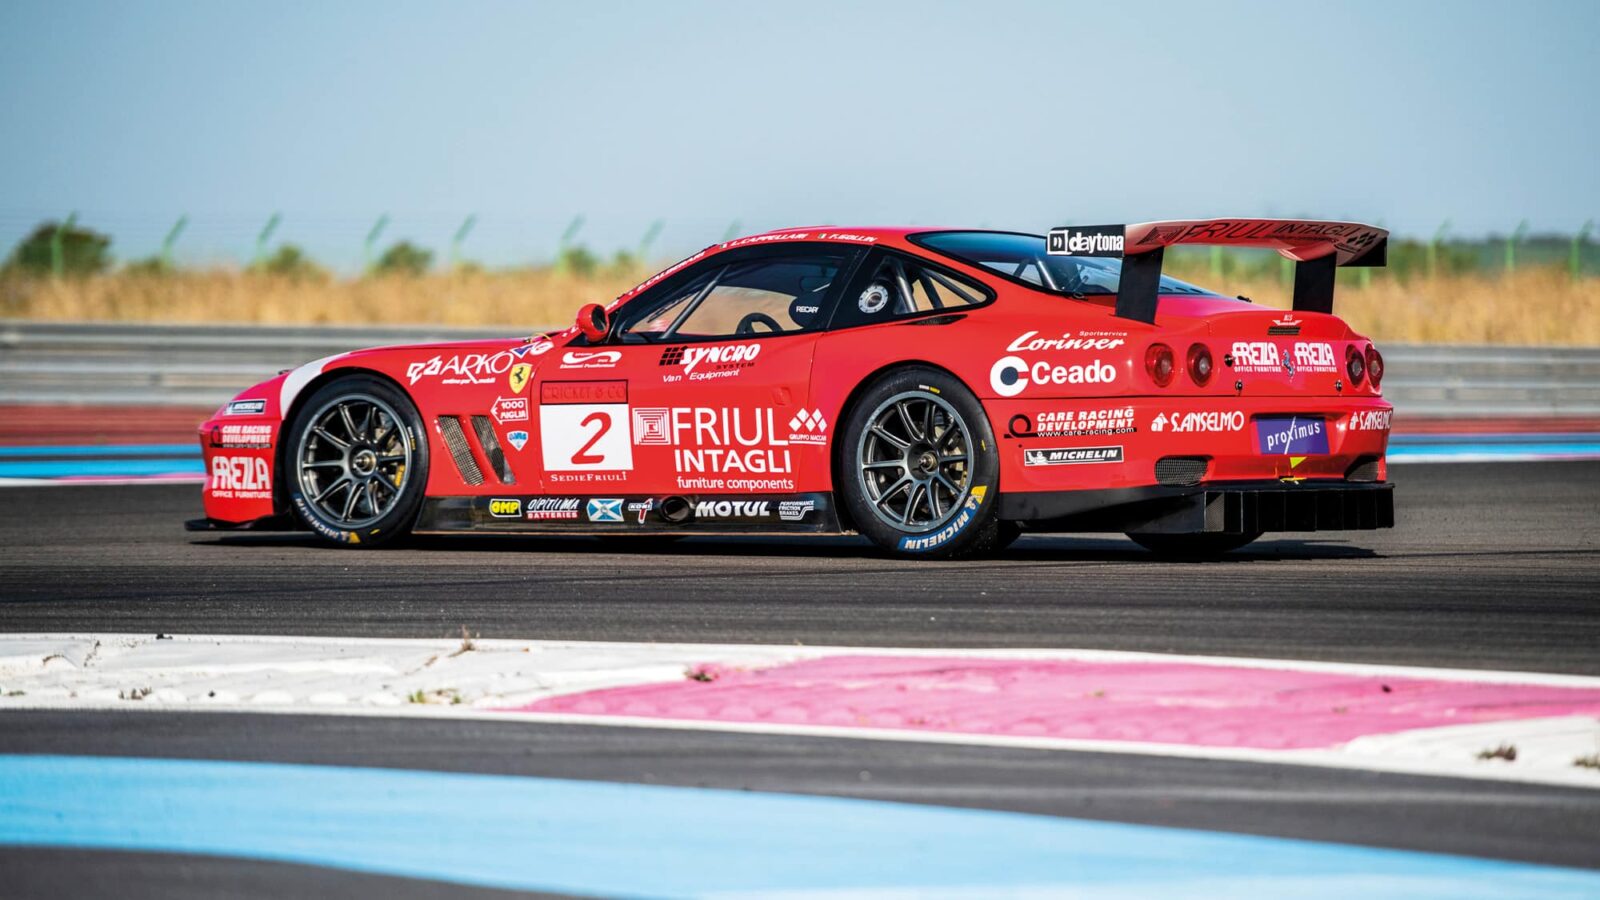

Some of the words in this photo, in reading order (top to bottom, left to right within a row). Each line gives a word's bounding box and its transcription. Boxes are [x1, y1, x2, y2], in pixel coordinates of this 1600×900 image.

[1174, 222, 1273, 243] FRIUL
[1273, 223, 1360, 237] INTAGLI
[1068, 231, 1124, 254] daytona
[796, 305, 819, 313] RECAR
[1006, 330, 1125, 352] Lorinser
[680, 343, 761, 376] SYNCRO
[716, 362, 755, 370] SYSTEM
[663, 375, 682, 383] Van
[689, 369, 740, 381] Equipment
[1031, 359, 1117, 385] Ceado
[543, 384, 591, 399] CRICKET
[501, 400, 524, 409] 1000
[500, 410, 526, 419] MIGLIA
[1037, 411, 1074, 422] CARE
[1078, 407, 1135, 420] RACING
[1170, 411, 1245, 432] S.ANSELMO
[671, 407, 789, 446] FRIUL
[1036, 427, 1135, 438] www.care-racing.com
[1037, 418, 1135, 432] DEVELOPMENT
[571, 411, 612, 465] 2
[1267, 418, 1320, 454] proximus
[674, 449, 792, 473] INTAGLI
[1049, 449, 1118, 460] MICHELIN
[677, 476, 724, 489] furniture
[726, 477, 794, 491] components
[212, 490, 233, 498] OFFICE
[235, 490, 272, 499] FURNITURE
[491, 501, 519, 513] OMP
[527, 498, 580, 510] OPTIMA
[695, 500, 770, 517] MOTUL
[527, 511, 579, 519] BATTERIES
[904, 510, 970, 549] MICHELIN
